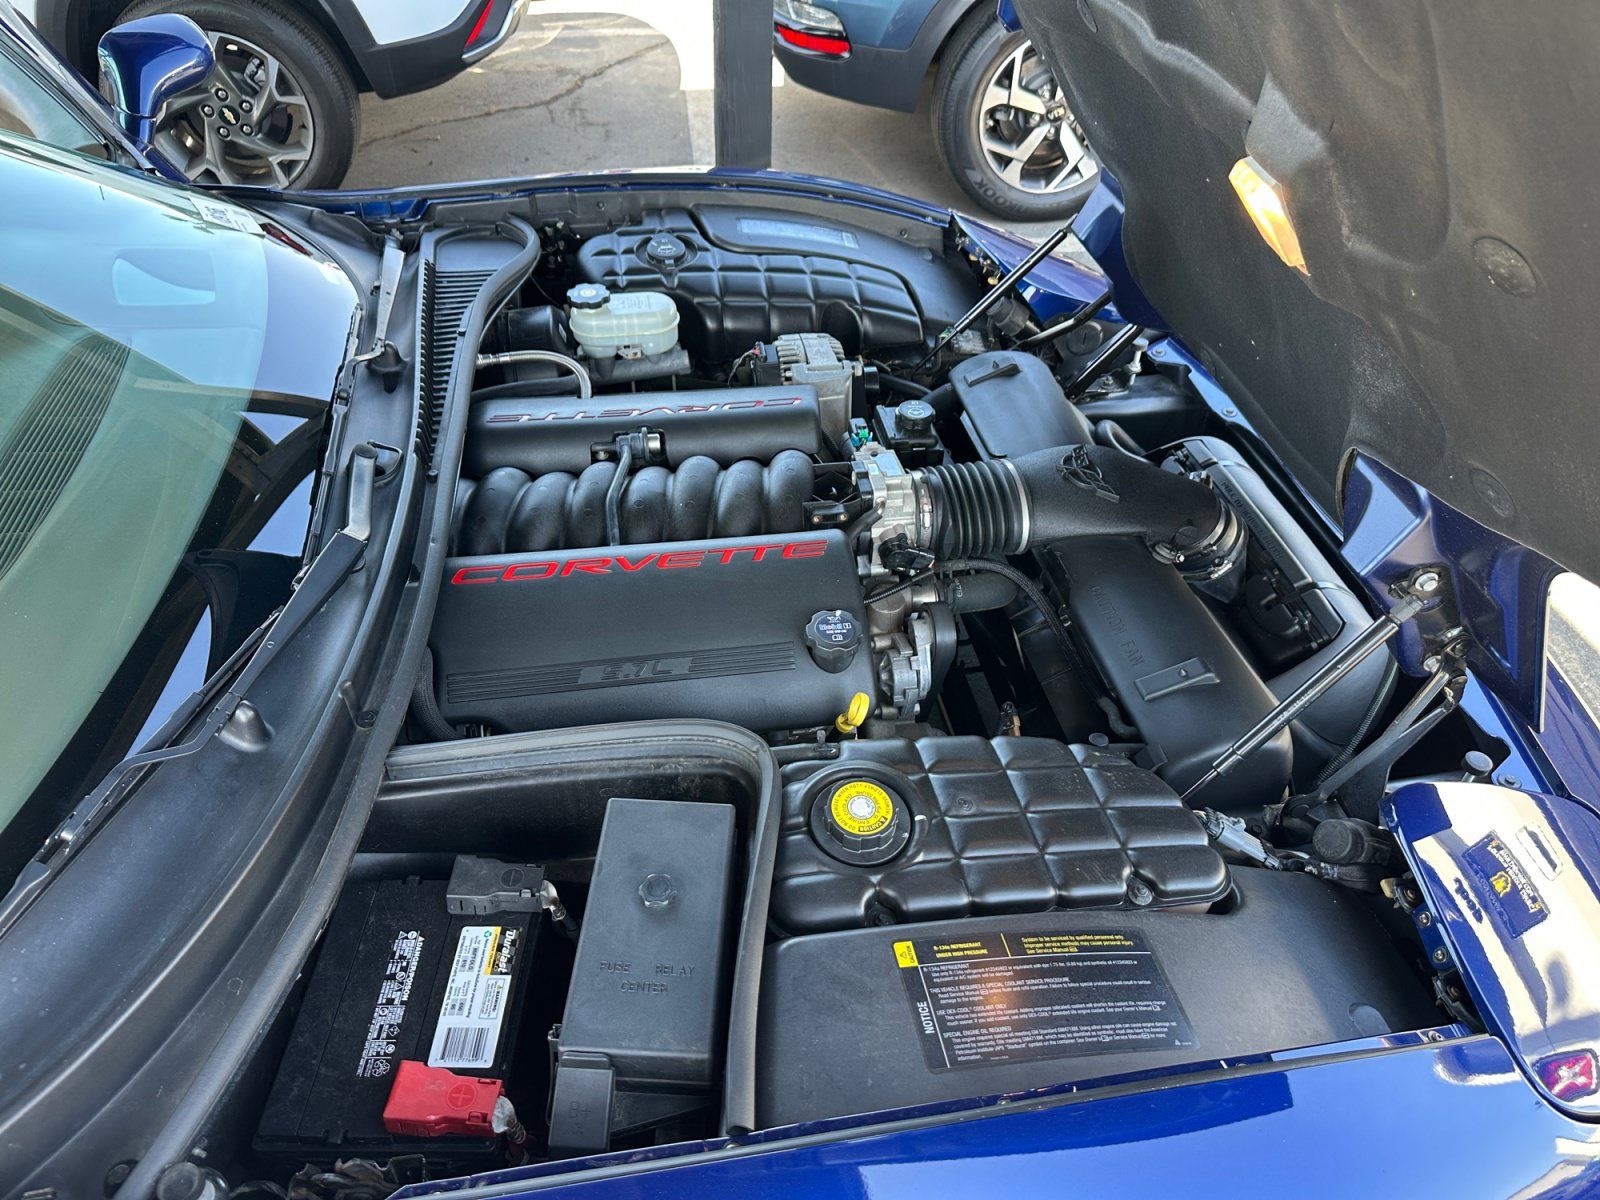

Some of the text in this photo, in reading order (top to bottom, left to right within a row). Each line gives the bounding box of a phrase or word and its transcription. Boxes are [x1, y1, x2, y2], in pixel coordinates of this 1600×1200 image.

[486, 397, 802, 423] CORVETTE
[451, 539, 828, 585] CORVETTE
[818, 623, 843, 631] Mobil
[1120, 638, 1146, 667] FAN
[602, 660, 675, 682] 5.7L
[501, 930, 515, 973] Duralast
[401, 941, 423, 1001] DANGER/POISON
[599, 960, 696, 977] FUSE RELAY
[620, 980, 668, 994] CENTER
[917, 1001, 935, 1034] NOTICE
